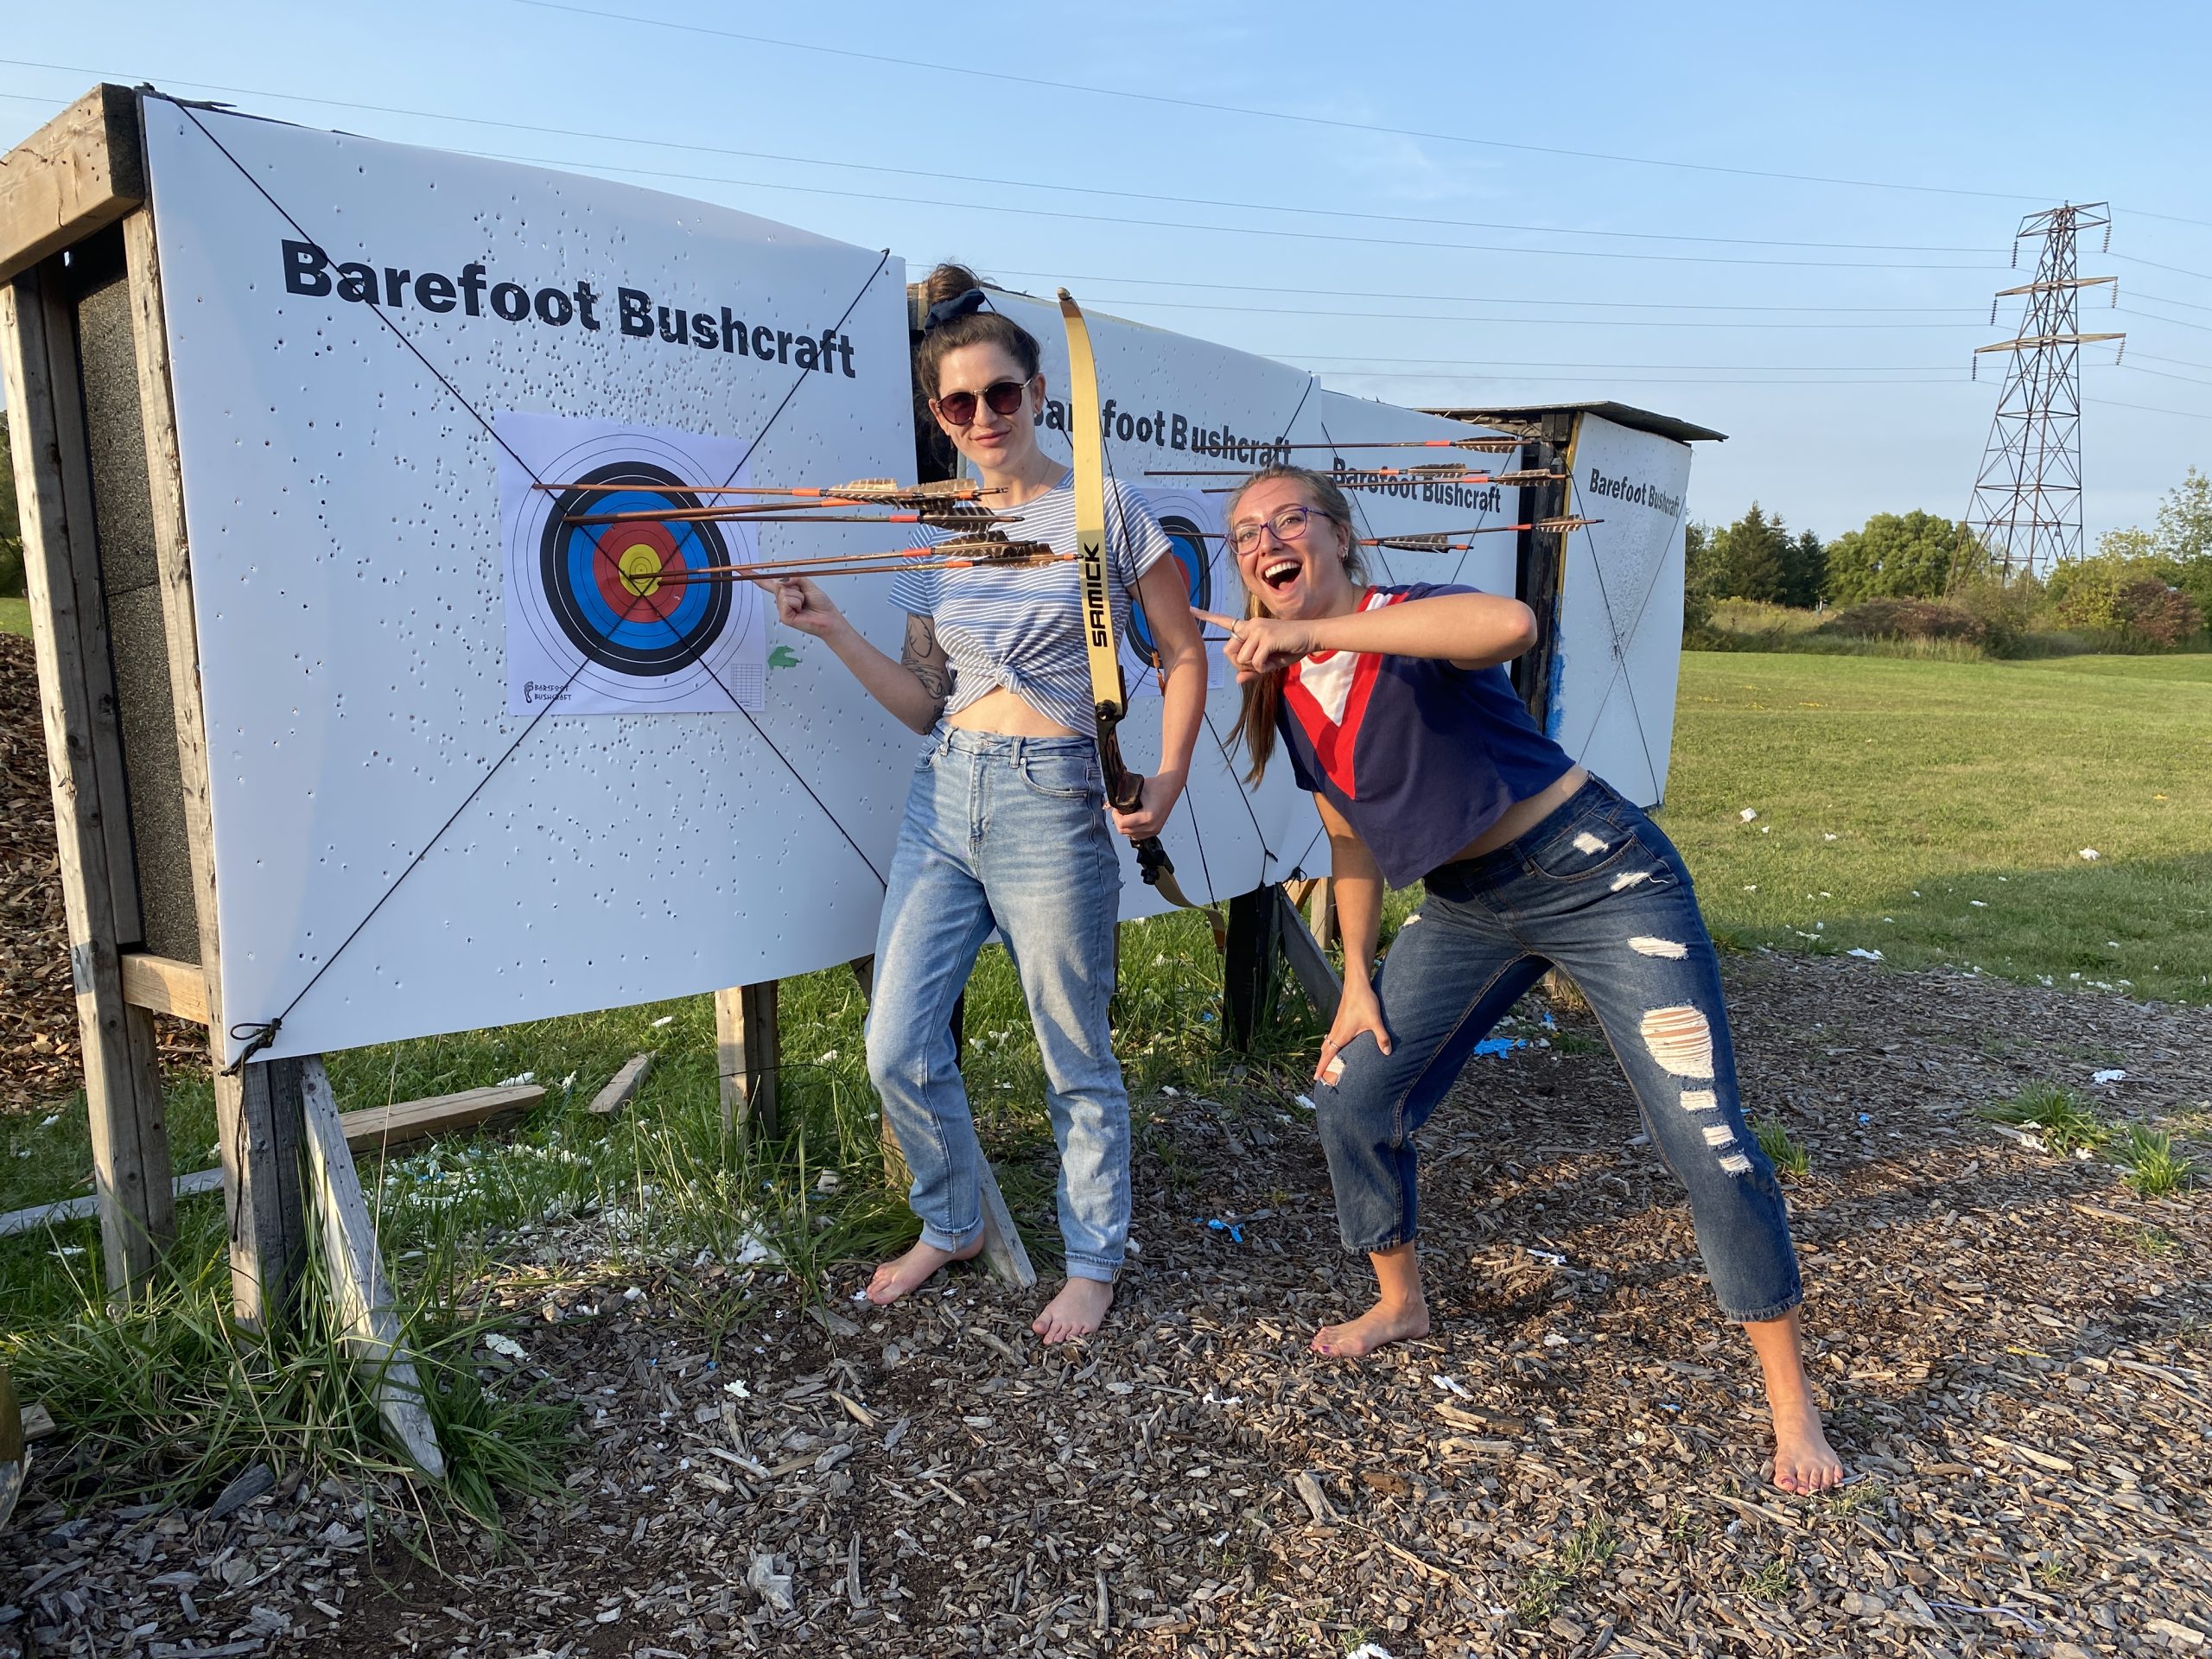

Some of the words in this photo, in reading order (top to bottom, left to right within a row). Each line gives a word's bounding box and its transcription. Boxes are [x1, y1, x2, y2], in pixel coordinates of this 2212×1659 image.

[281, 238, 601, 331] Barefoot
[618, 286, 856, 378] Bushcraft
[1034, 399, 1166, 447] afoot
[1171, 413, 1292, 468] Bushcraft
[1333, 456, 1418, 500] Barefoot
[1423, 474, 1501, 513] Bushcraft
[1589, 467, 1647, 505] Barefoot
[1648, 485, 1680, 518] Bushcraft
[1084, 543, 1108, 648] SAMICK
